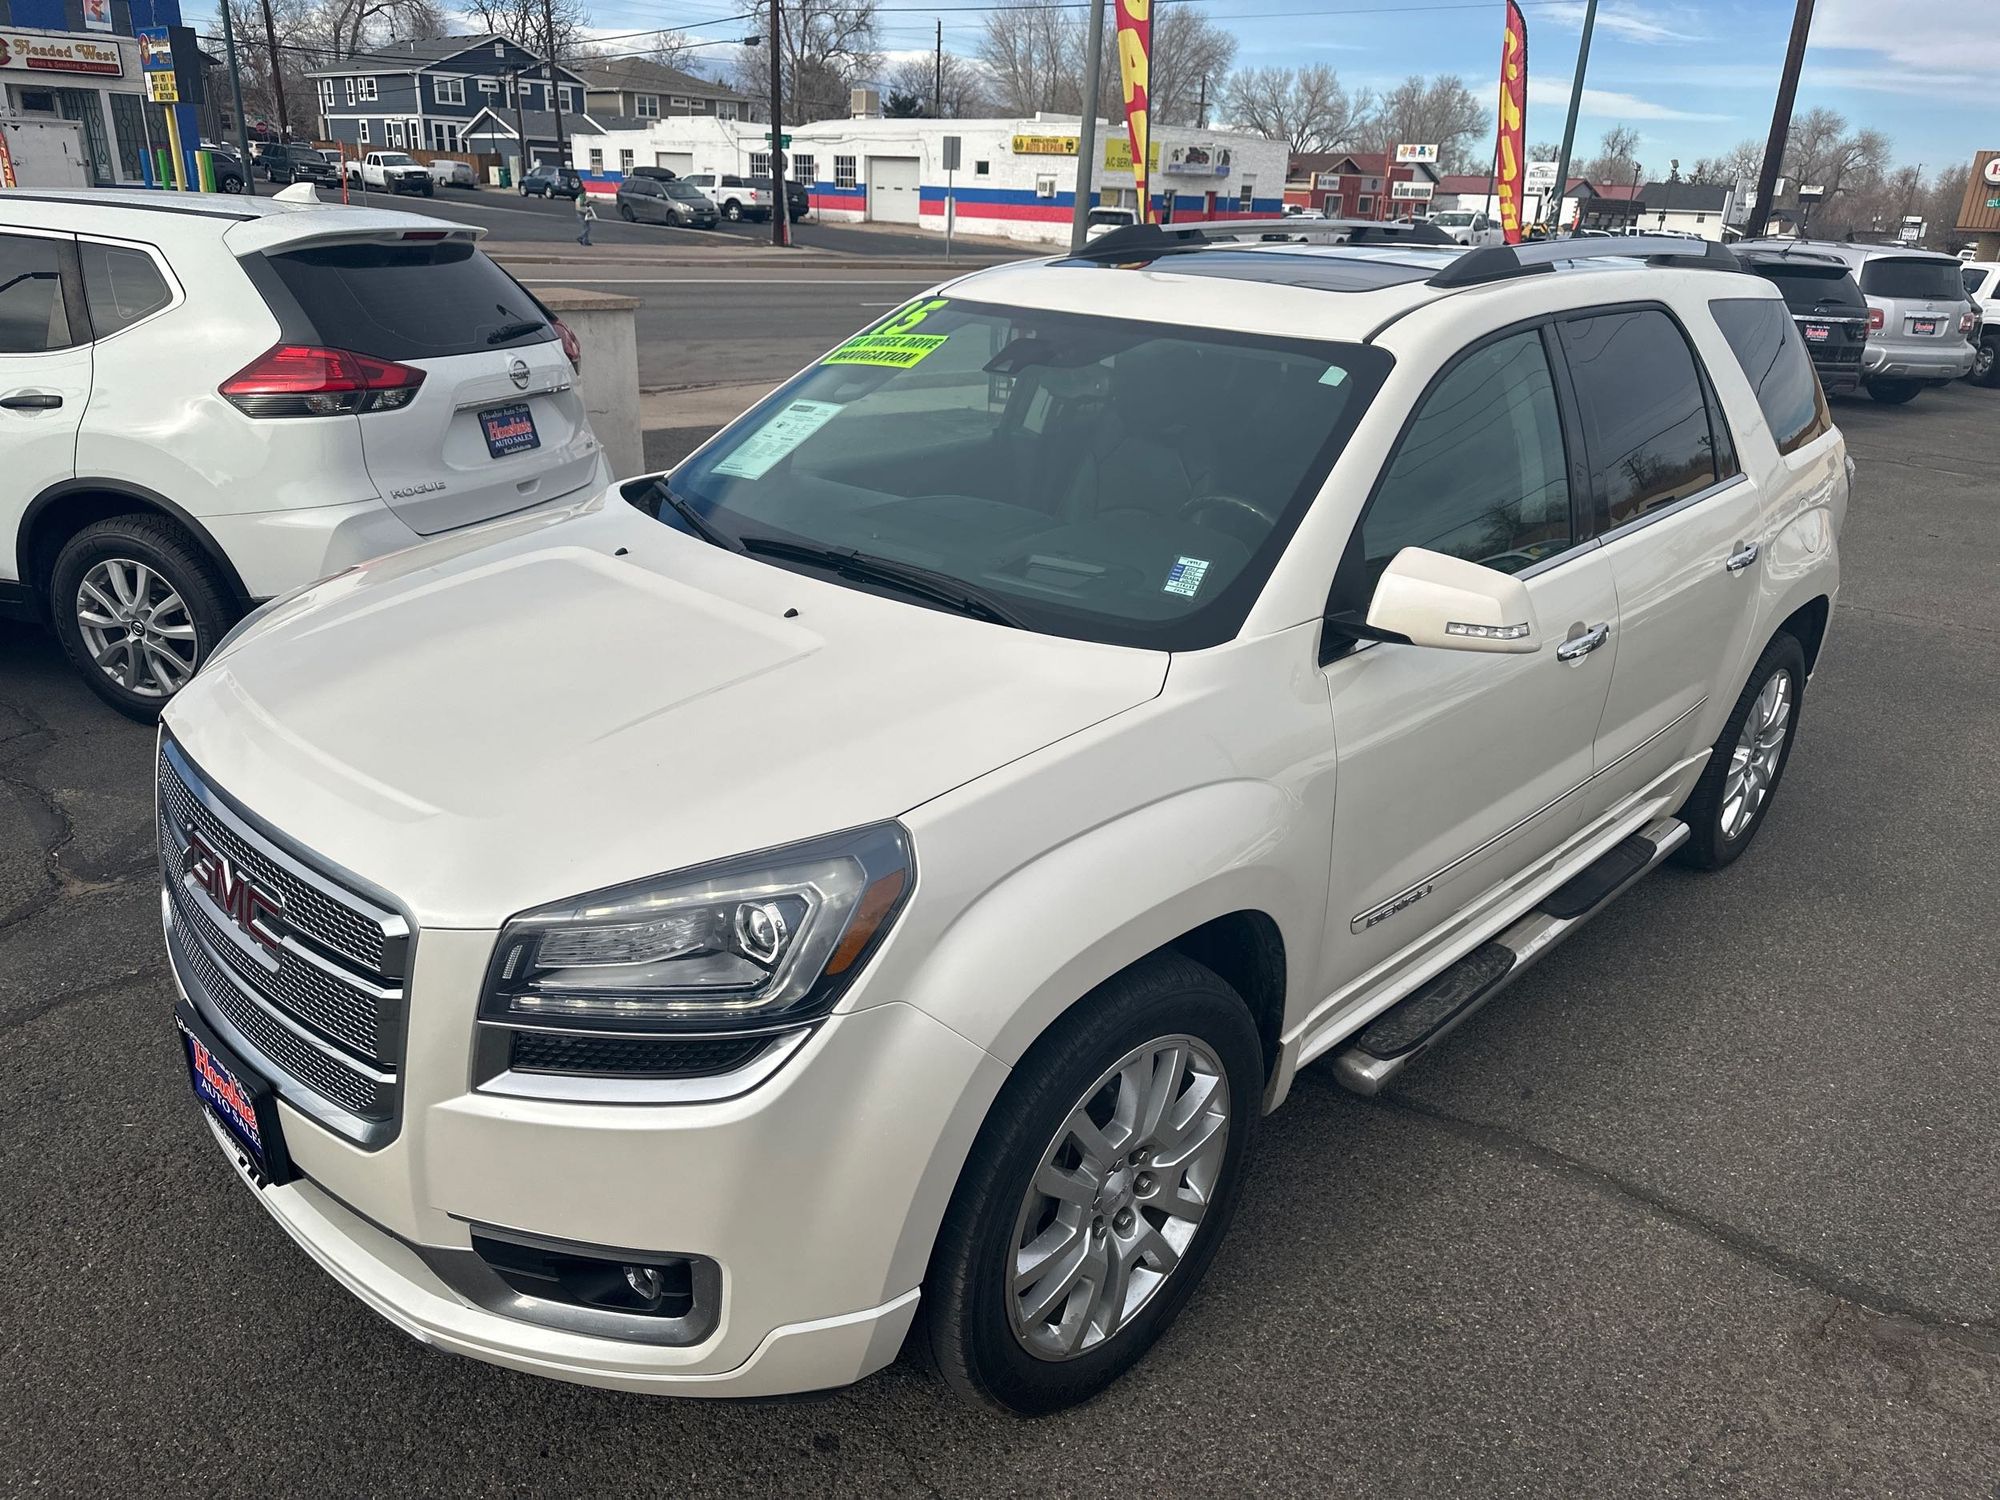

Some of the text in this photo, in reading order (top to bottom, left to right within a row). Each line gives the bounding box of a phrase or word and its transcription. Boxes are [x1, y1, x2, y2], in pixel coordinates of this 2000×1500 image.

[13, 39, 117, 61] Headed West
[829, 350, 920, 363] NAVIGATION
[389, 481, 447, 500] ROGUE
[190, 829, 284, 952] GMC
[201, 1078, 231, 1114] AUTO
